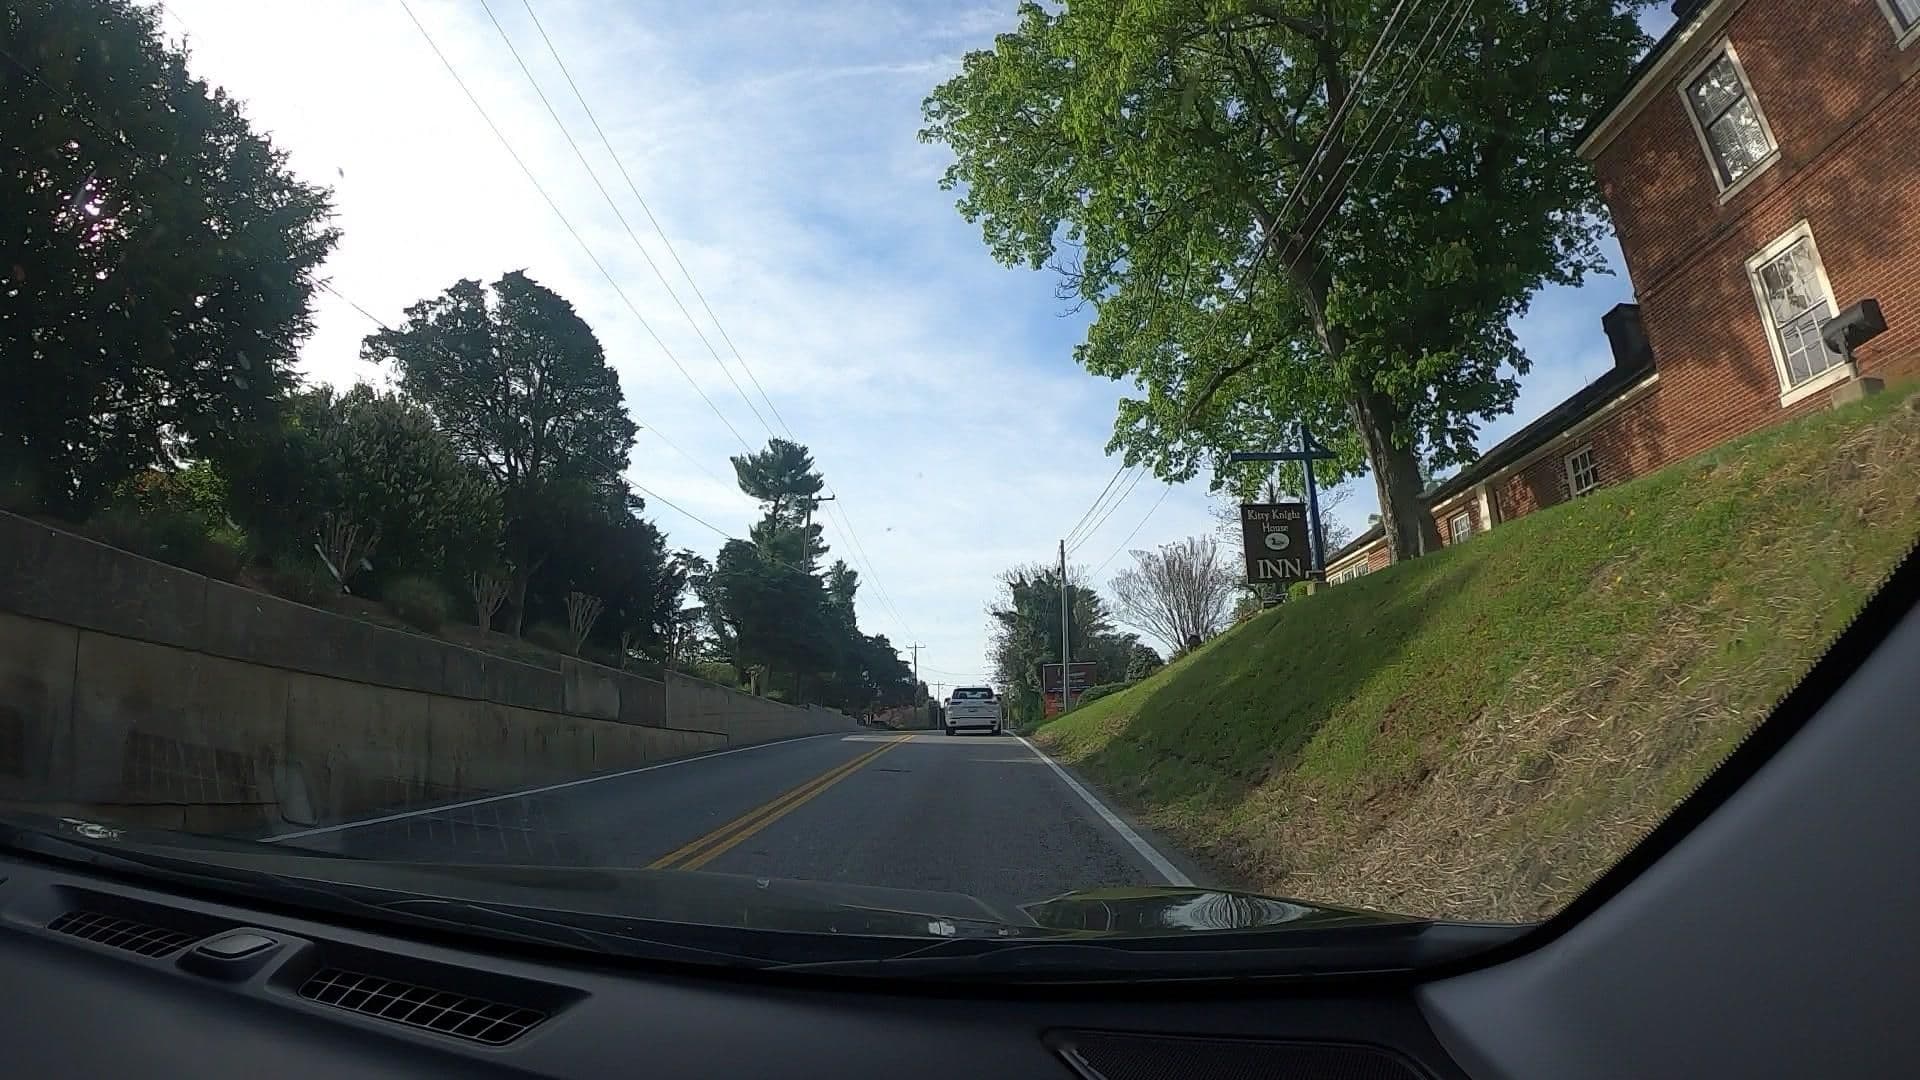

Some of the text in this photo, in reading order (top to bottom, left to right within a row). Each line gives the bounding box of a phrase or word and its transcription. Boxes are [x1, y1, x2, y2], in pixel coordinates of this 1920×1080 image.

[1248, 509, 1301, 521] Kitty Knight
[1262, 522, 1289, 533] House
[1257, 558, 1301, 579] INN
